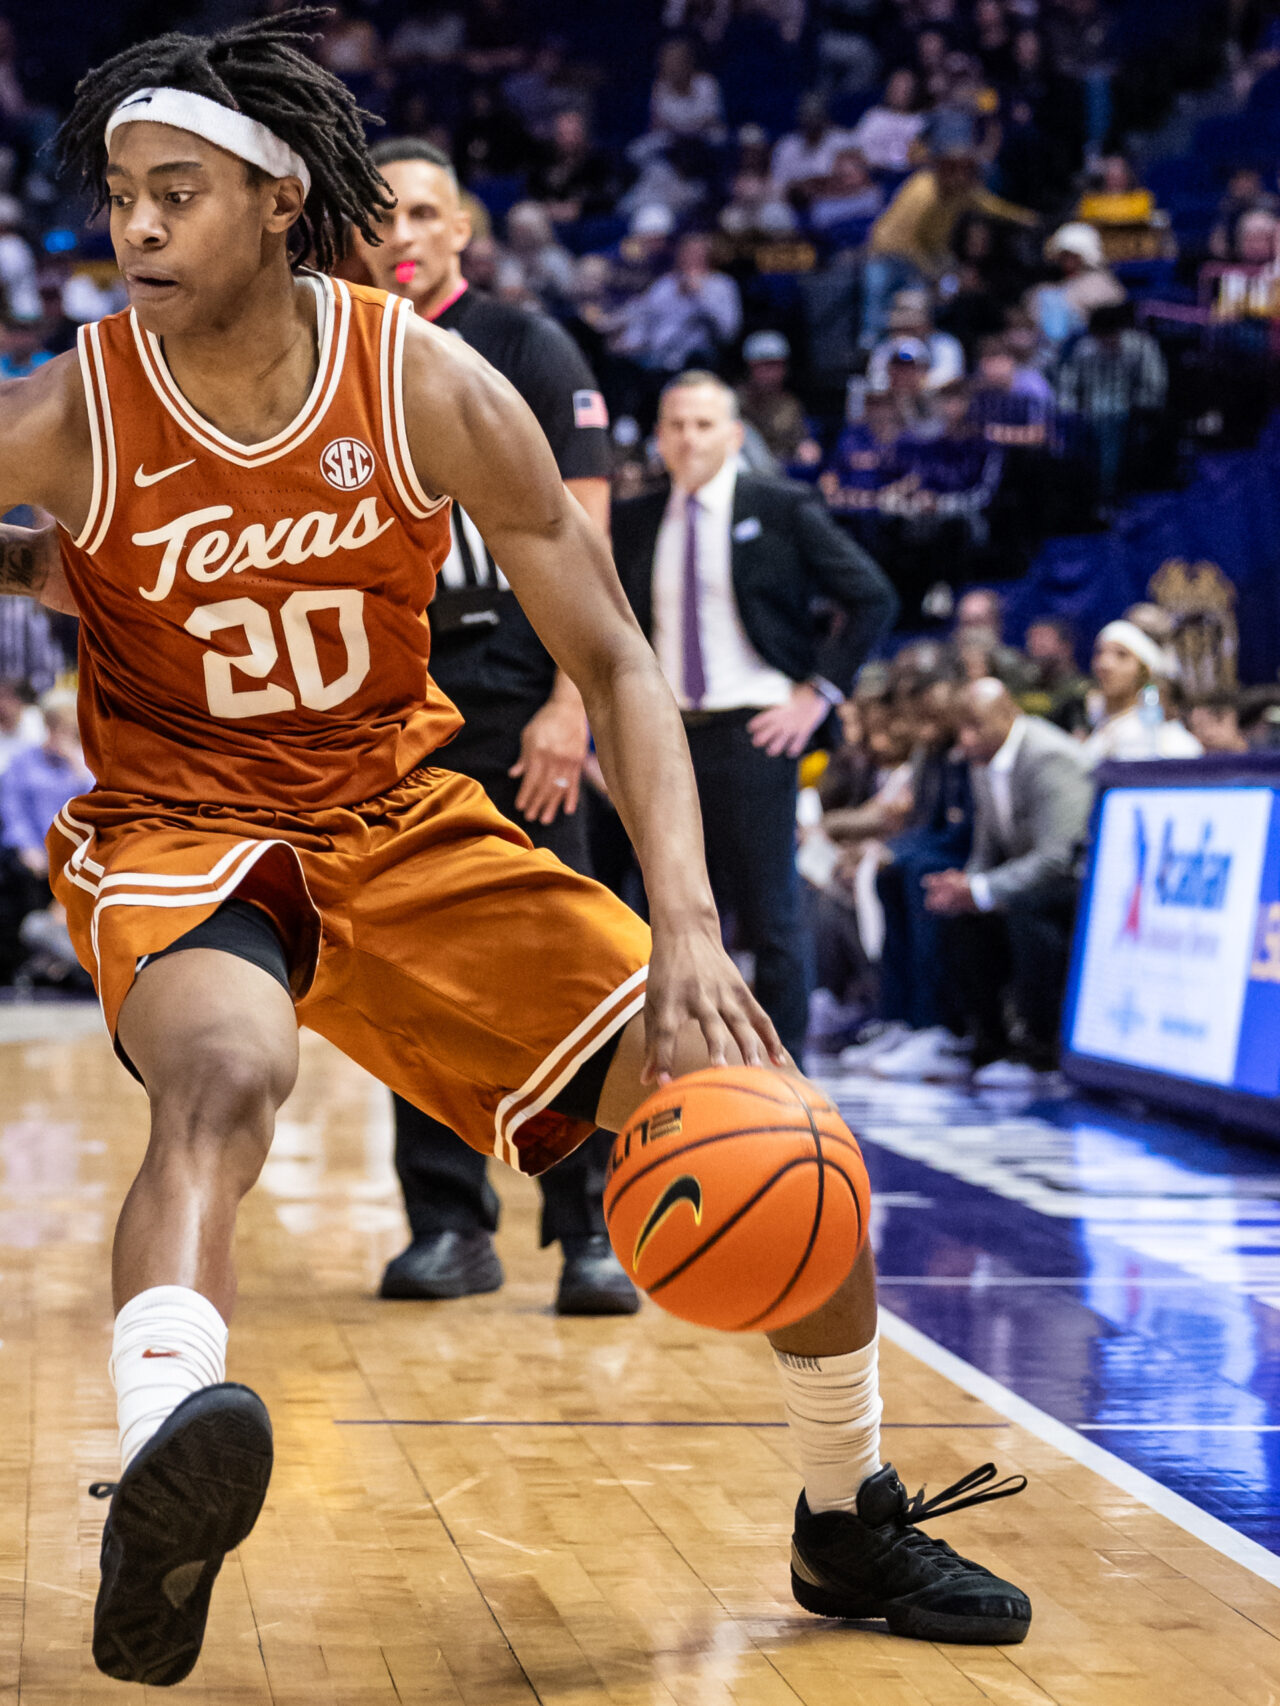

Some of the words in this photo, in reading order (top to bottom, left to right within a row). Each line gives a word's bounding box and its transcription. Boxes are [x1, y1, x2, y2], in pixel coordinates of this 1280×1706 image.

[324, 441, 370, 487] SEC
[131, 496, 395, 602] Texas
[183, 588, 370, 719] 20
[606, 1105, 683, 1184] LITE
